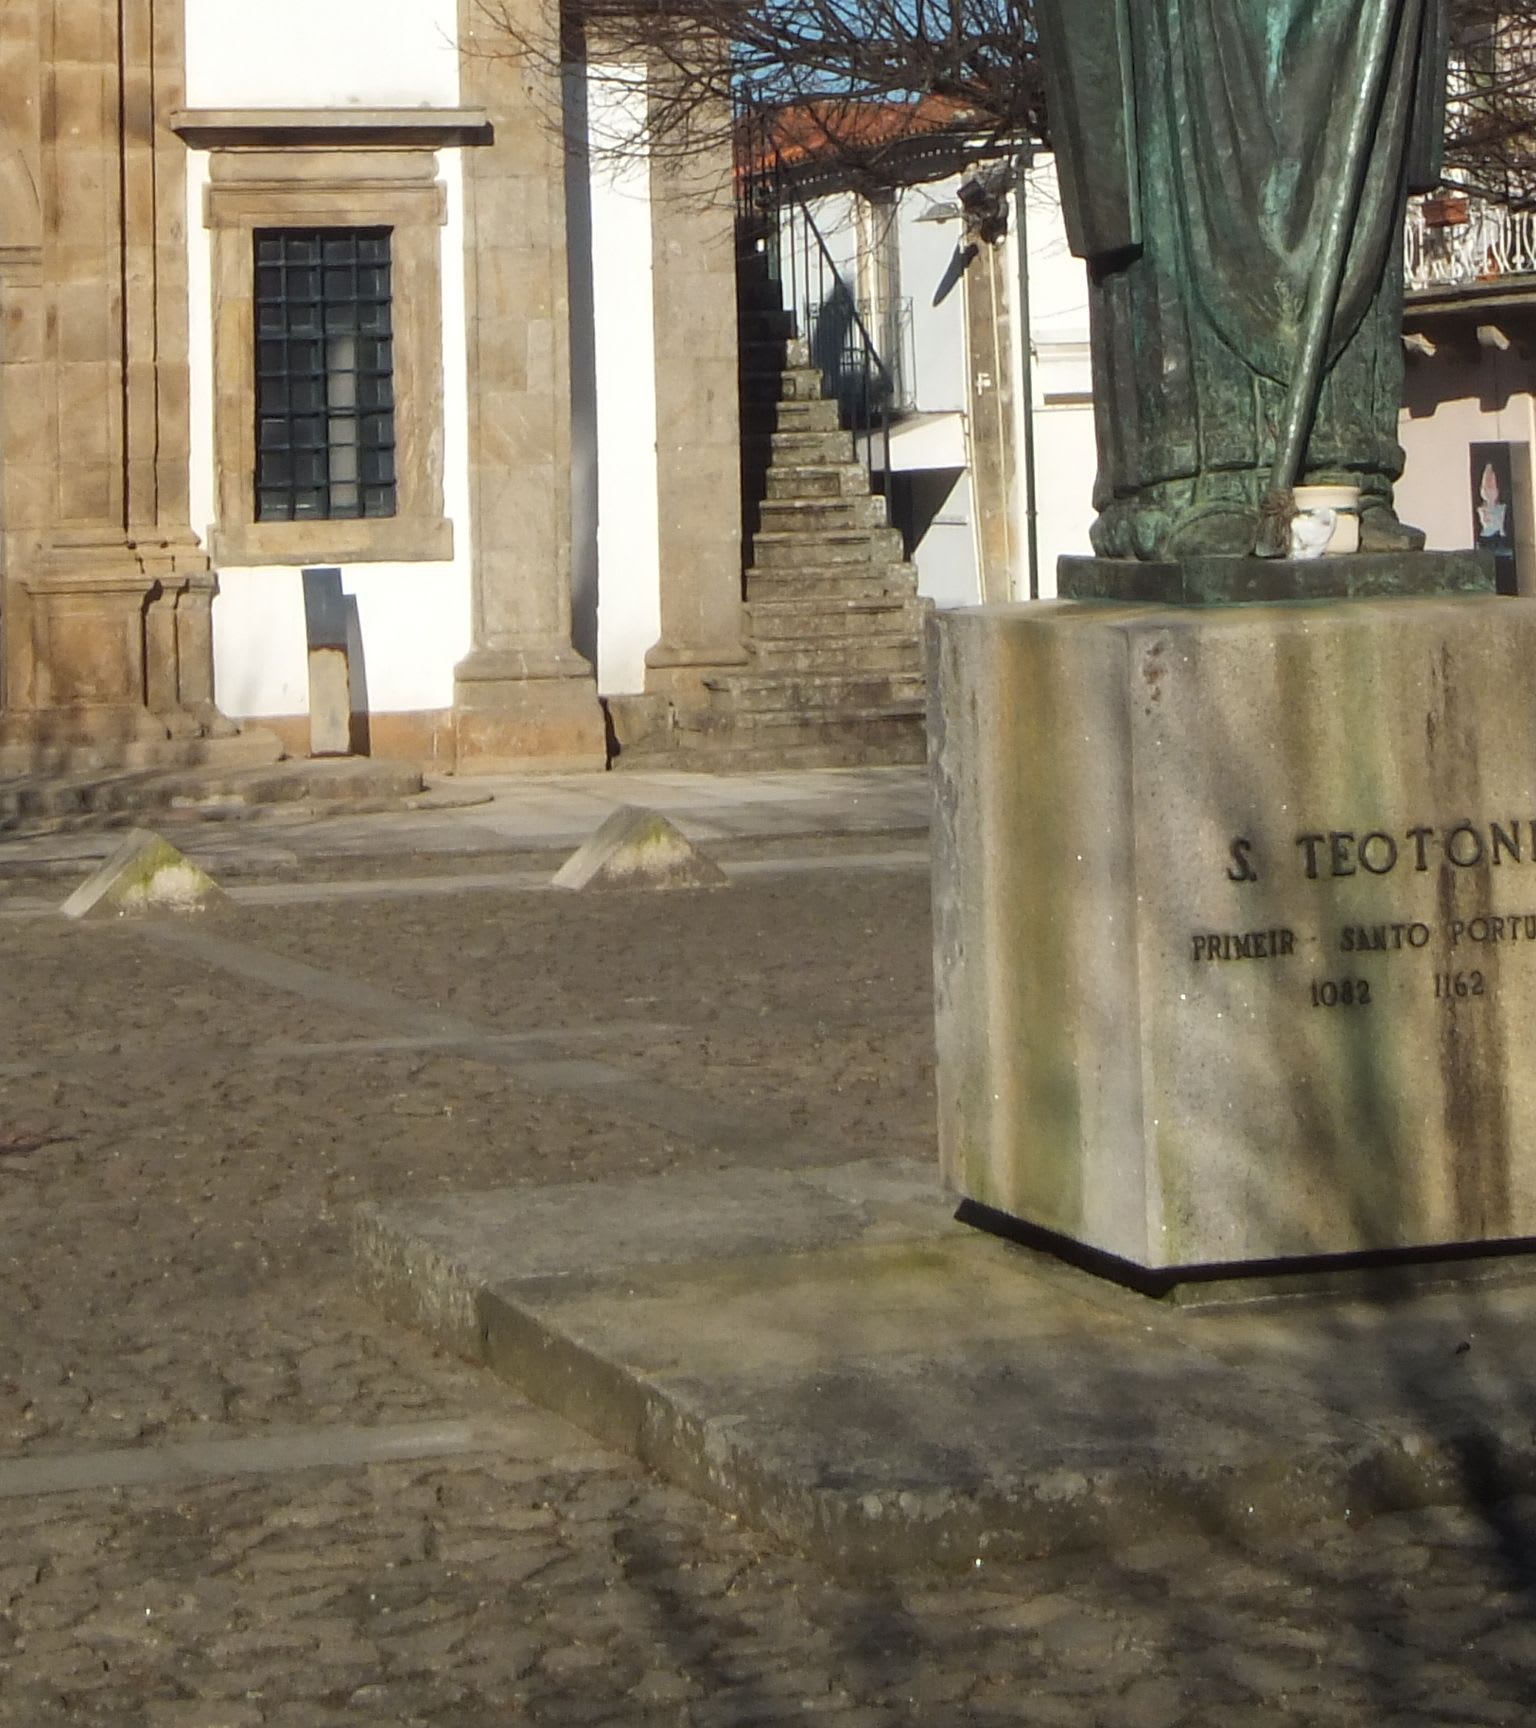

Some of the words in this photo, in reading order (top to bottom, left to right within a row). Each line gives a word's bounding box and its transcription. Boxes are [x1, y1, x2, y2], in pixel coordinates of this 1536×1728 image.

[1226, 836, 1257, 882] S.
[1340, 922, 1430, 953] SANTO
[1311, 978, 1372, 1008] 1082
[1435, 970, 1485, 998] 1162
